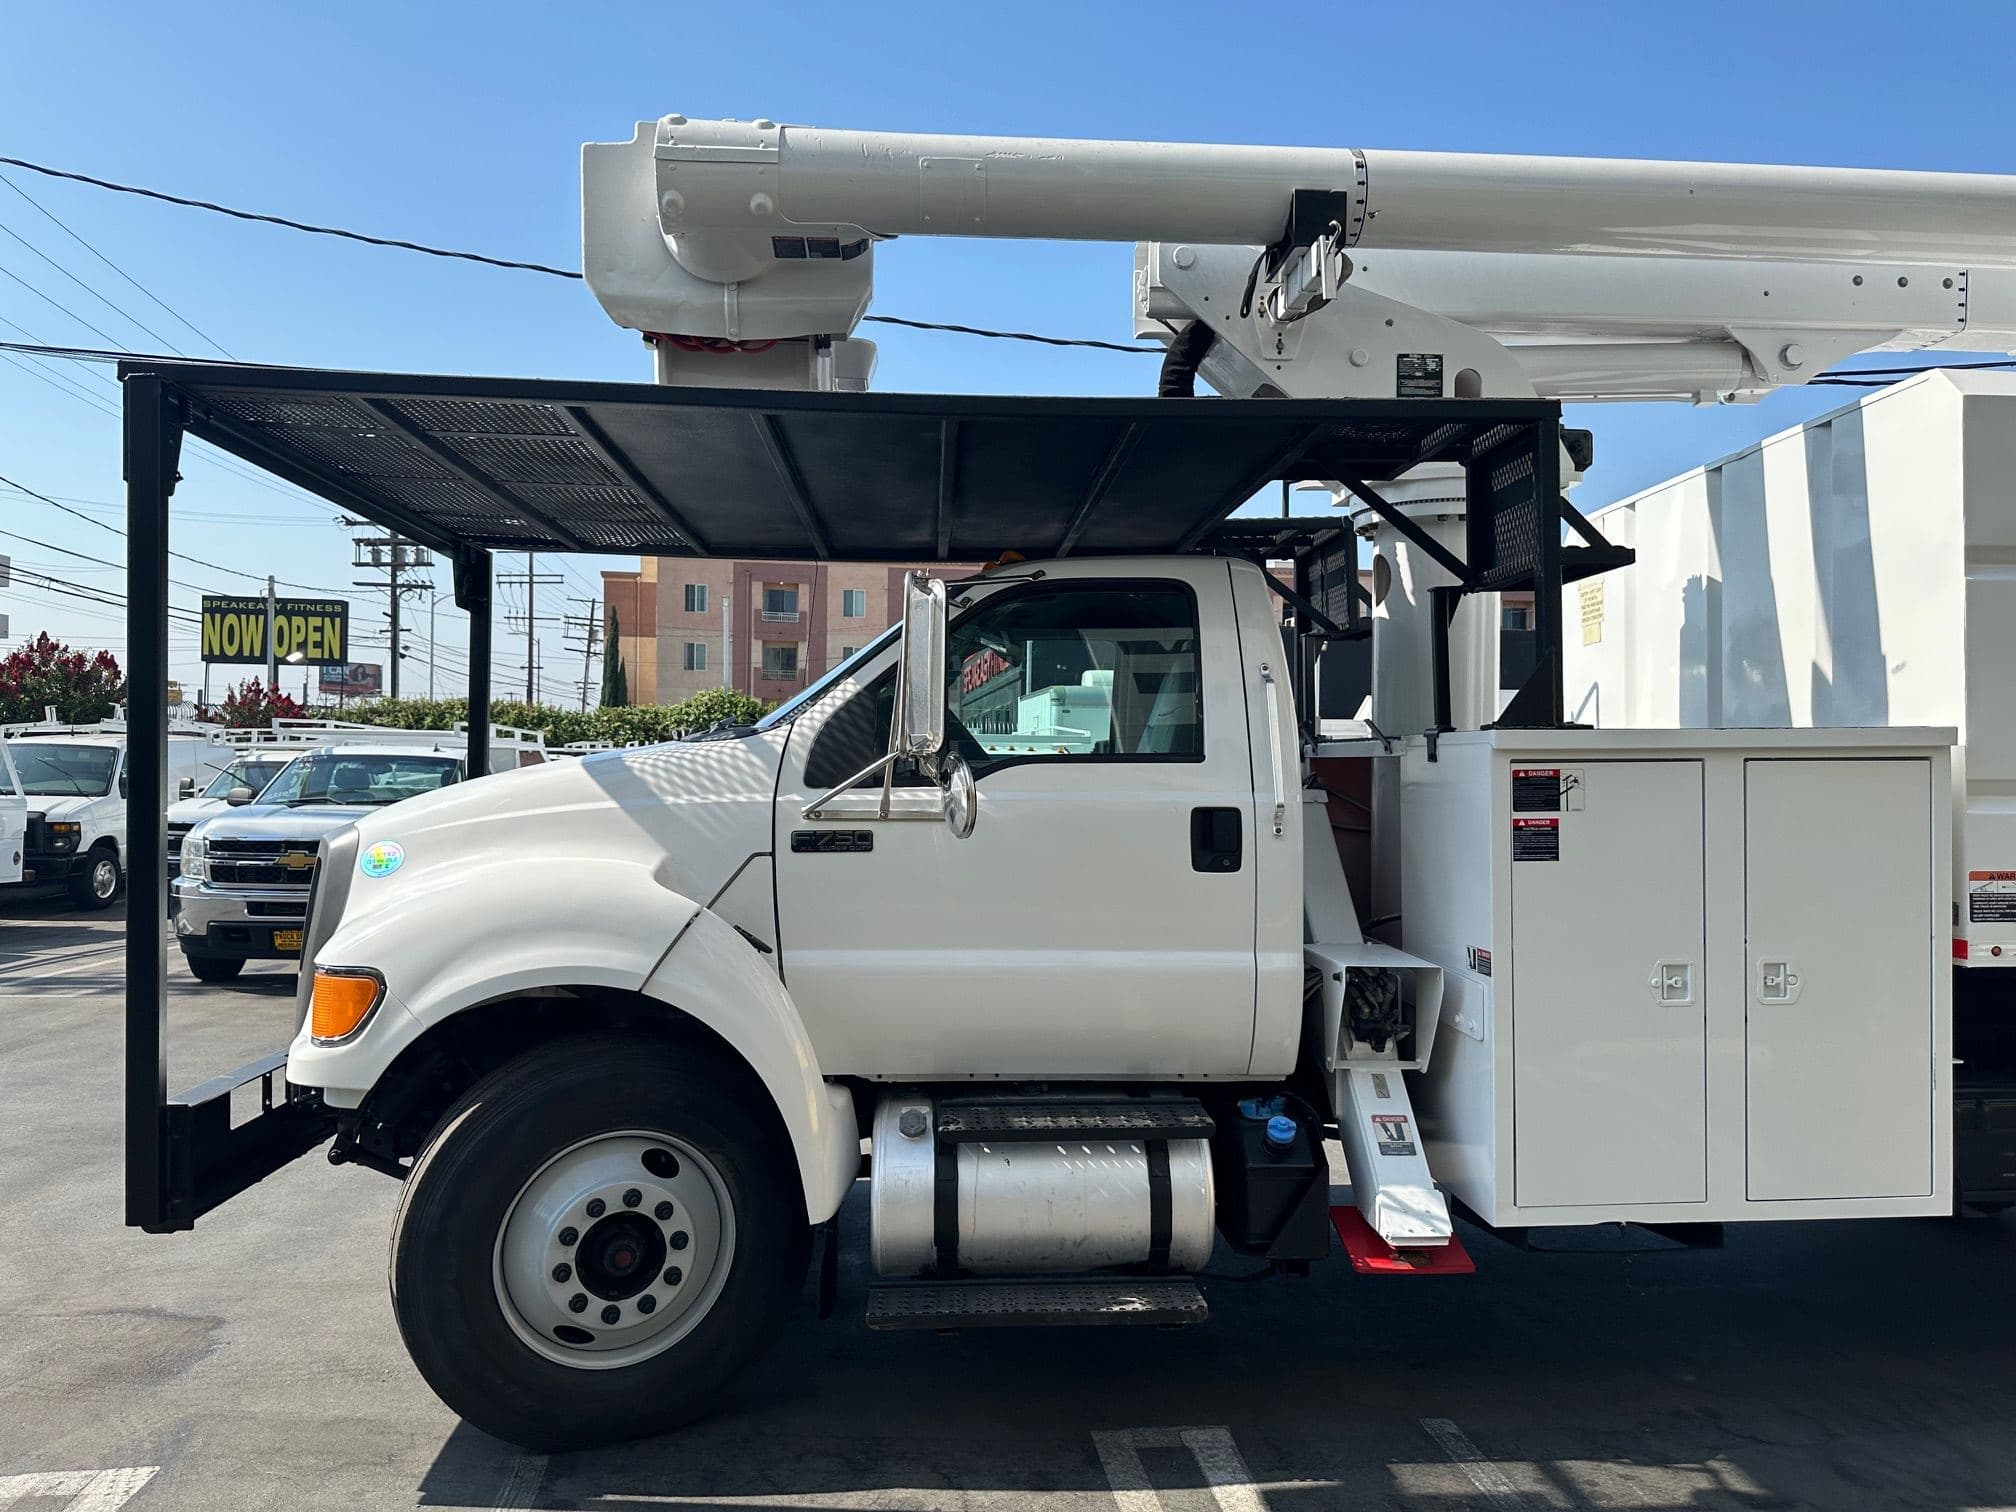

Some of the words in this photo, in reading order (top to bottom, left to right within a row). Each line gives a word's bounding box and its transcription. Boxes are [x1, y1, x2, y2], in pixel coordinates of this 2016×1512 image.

[203, 600, 282, 611] SPEAKEAY
[287, 603, 342, 612] FITNESS
[203, 613, 264, 657] NOW
[273, 615, 341, 660] OPEN
